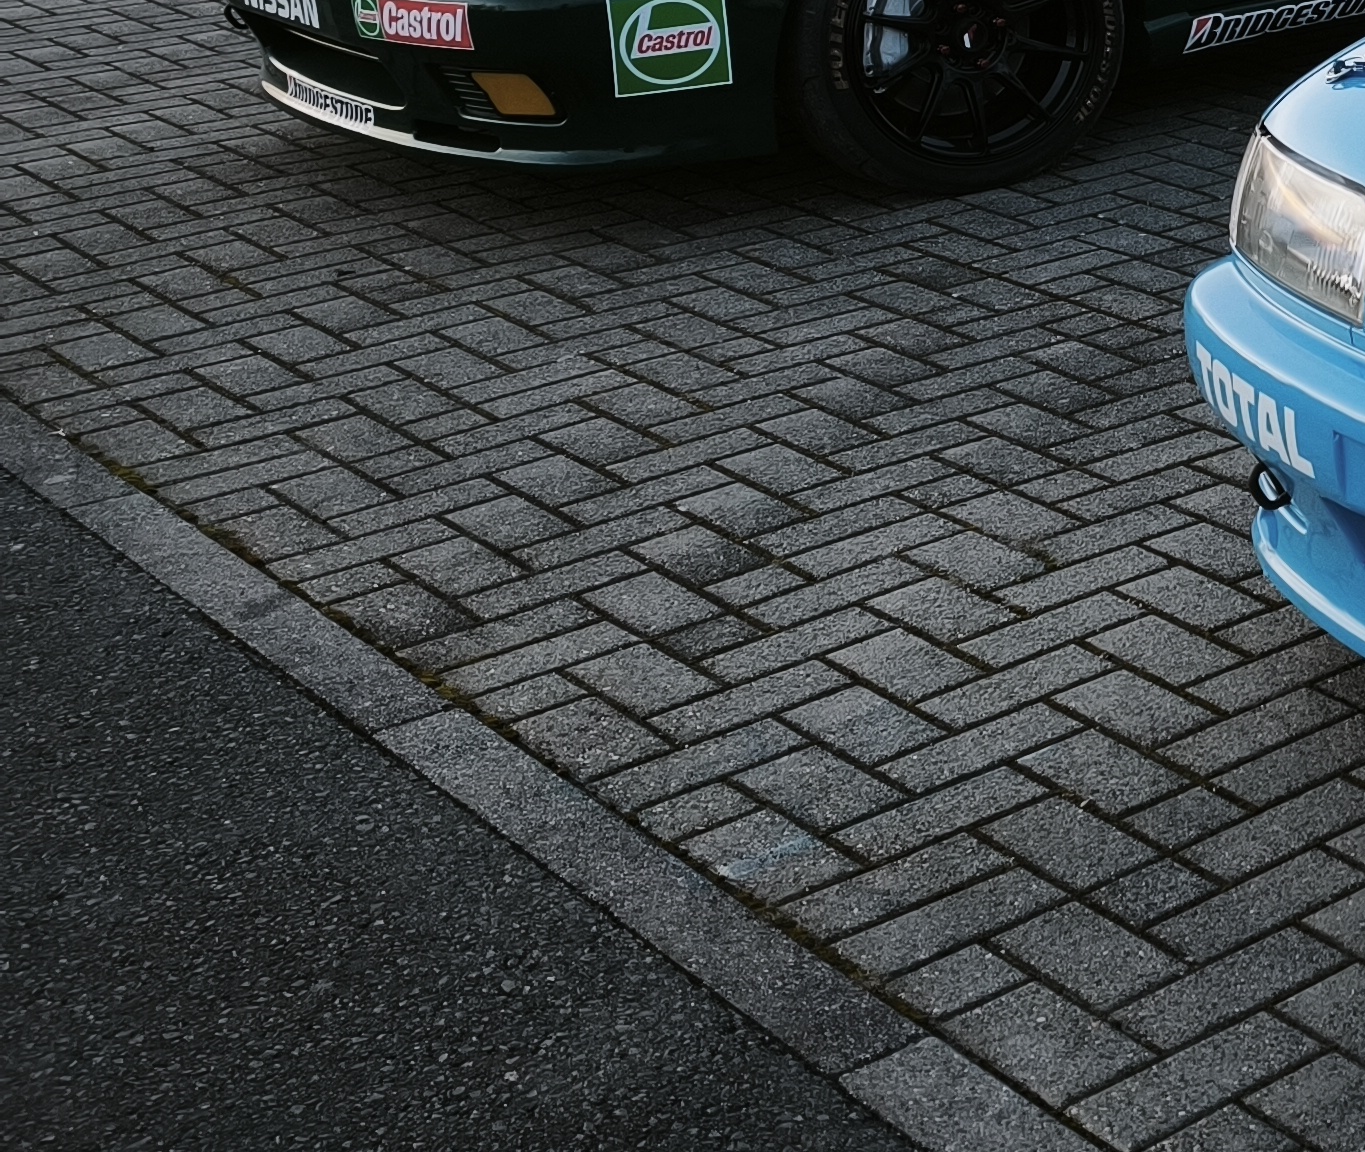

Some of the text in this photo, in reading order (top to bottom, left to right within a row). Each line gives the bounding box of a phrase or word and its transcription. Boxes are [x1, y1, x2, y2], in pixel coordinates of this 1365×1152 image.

[382, 0, 464, 43] Castrol
[636, 24, 714, 56] Castrol
[1195, 339, 1316, 479] TOTAL
